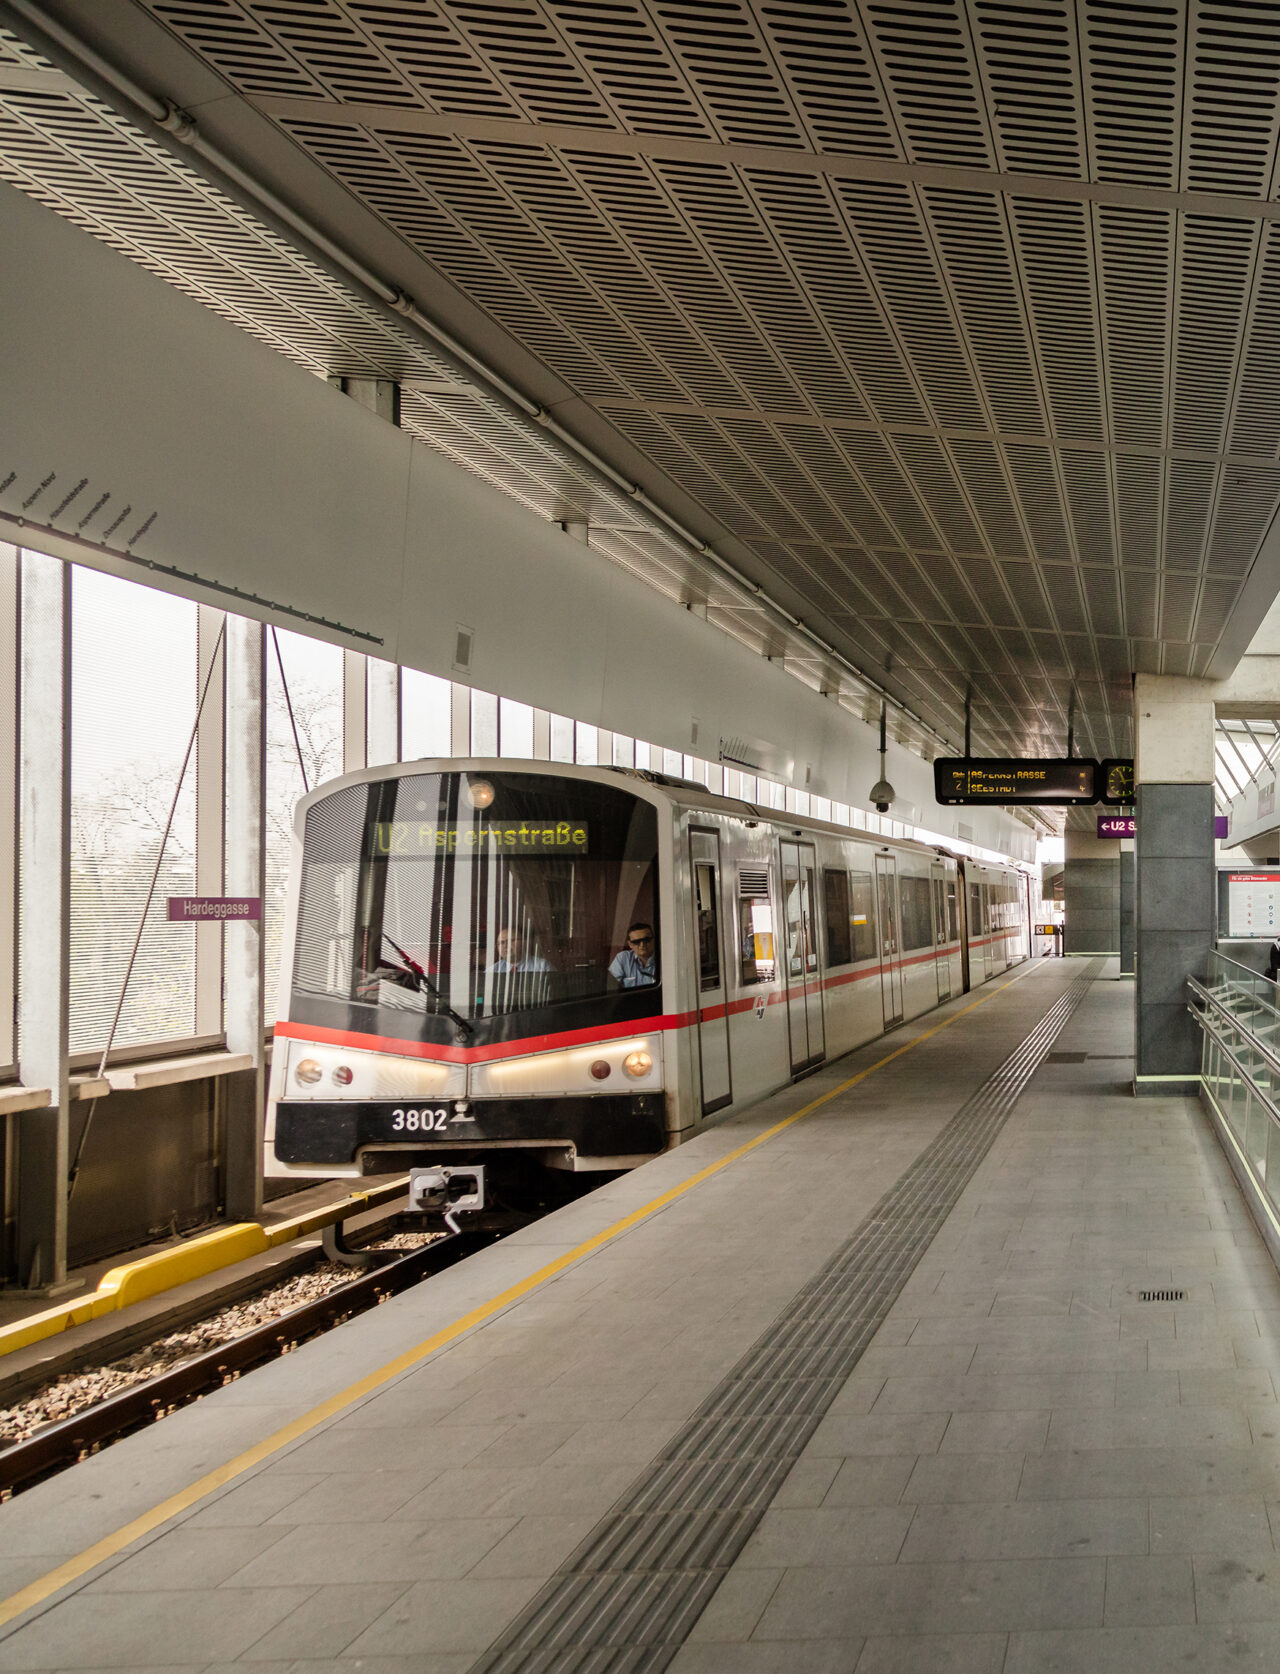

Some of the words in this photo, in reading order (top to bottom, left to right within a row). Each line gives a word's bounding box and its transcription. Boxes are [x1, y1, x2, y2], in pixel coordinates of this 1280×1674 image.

[1111, 821, 1125, 831] U2
[183, 900, 250, 918] Hardeggasse
[392, 1109, 447, 1131] 3802
